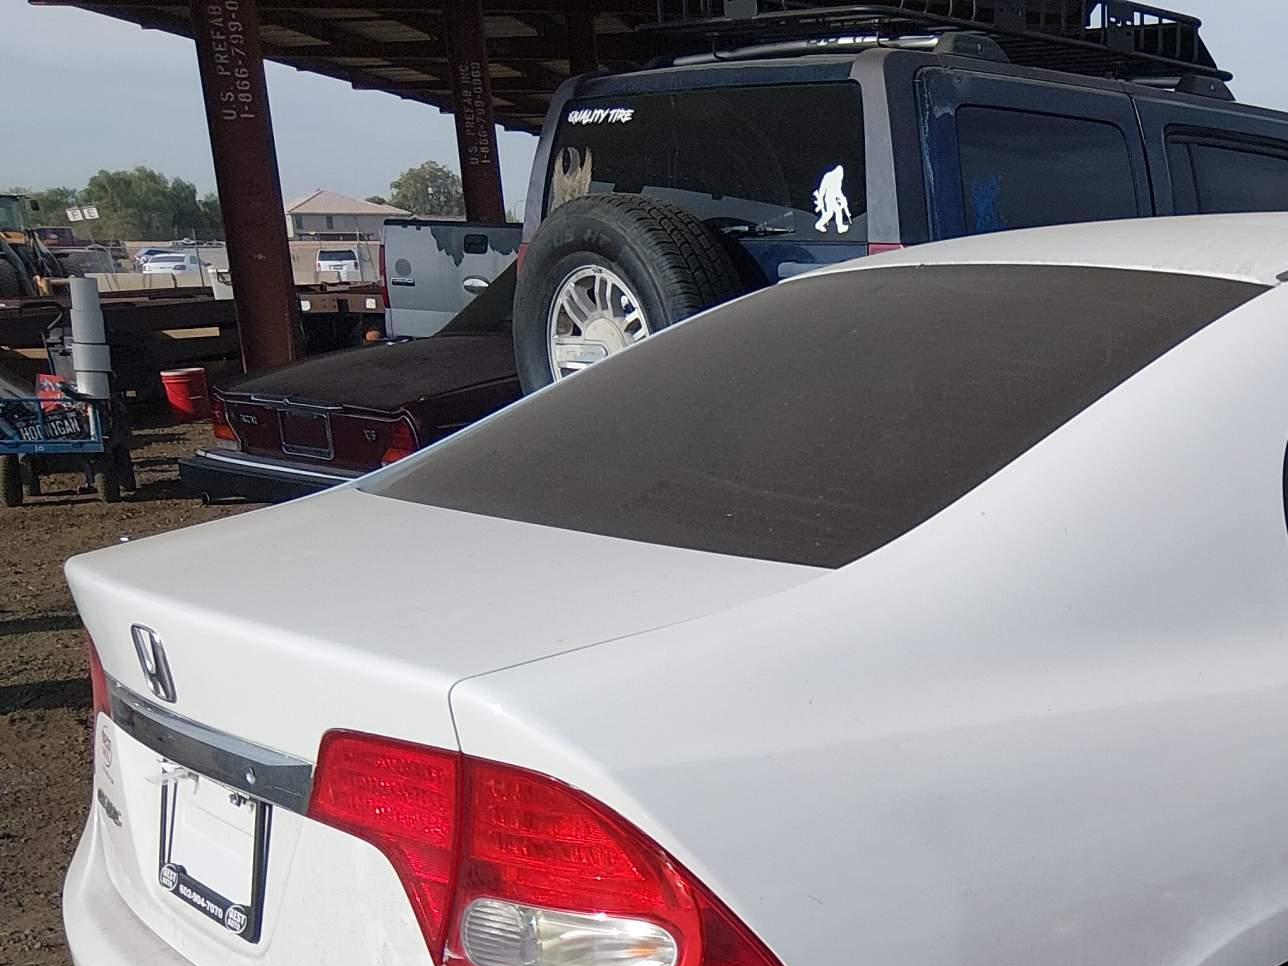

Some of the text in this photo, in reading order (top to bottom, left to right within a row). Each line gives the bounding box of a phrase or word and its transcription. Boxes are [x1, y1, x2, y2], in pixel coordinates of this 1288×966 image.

[208, 5, 237, 120] U.S. PREFAB
[568, 107, 635, 125] QUALITY TIRE
